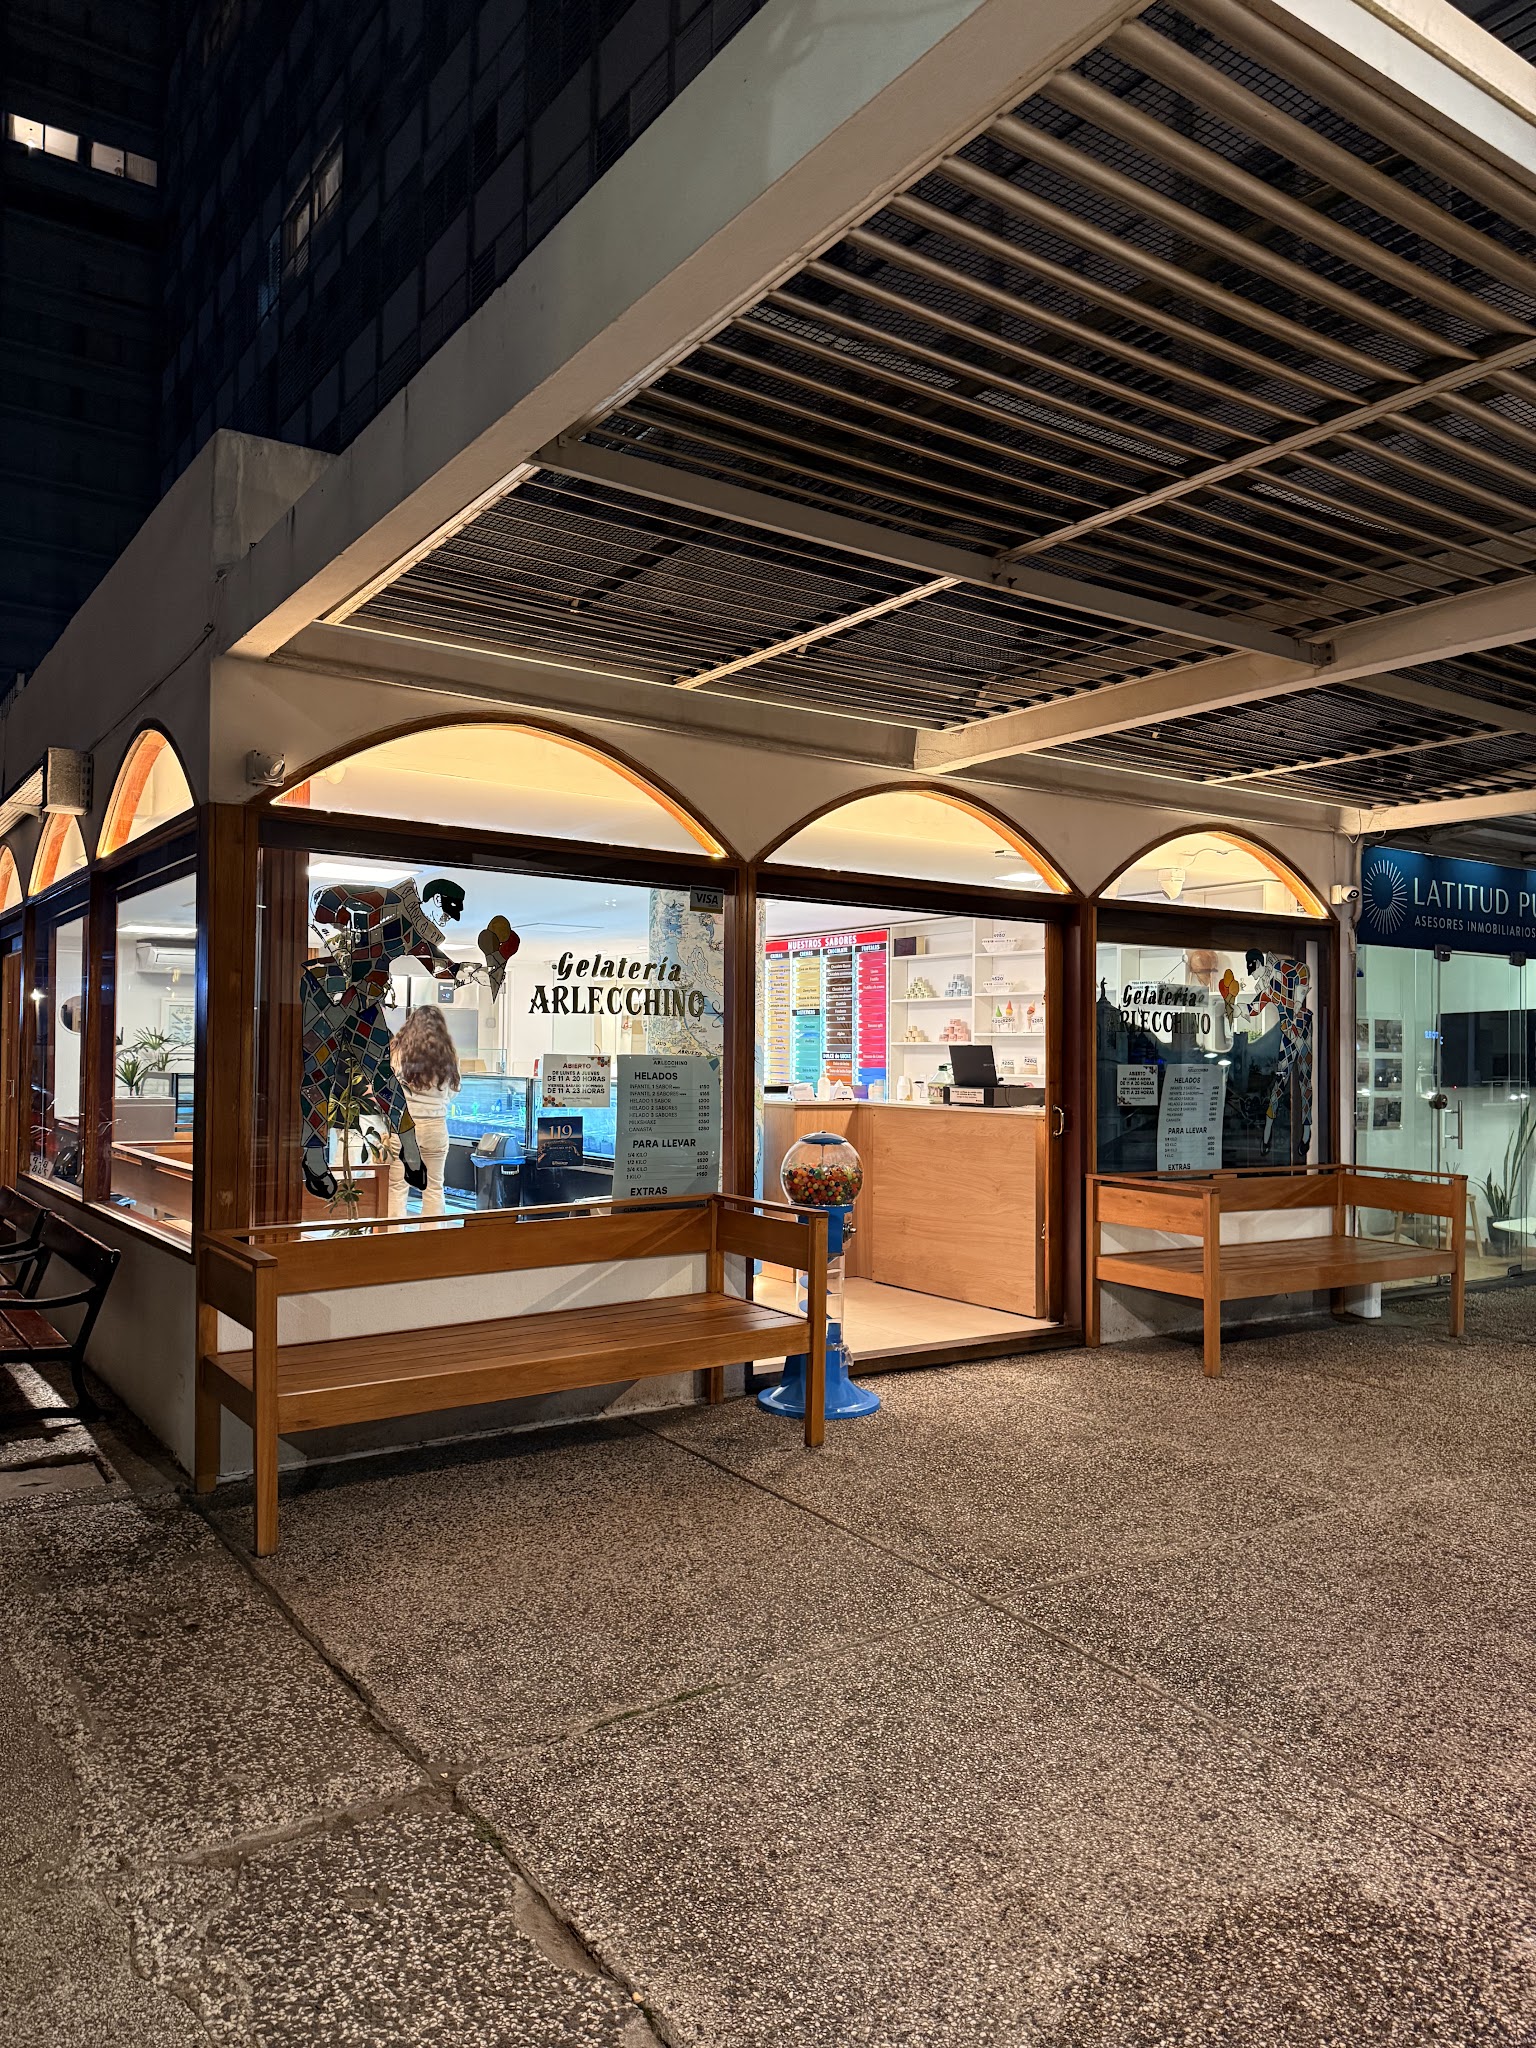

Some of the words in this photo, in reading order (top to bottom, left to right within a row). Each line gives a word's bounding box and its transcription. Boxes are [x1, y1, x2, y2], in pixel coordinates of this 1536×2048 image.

[695, 893, 719, 905] VISA
[1414, 877, 1509, 915] LATITUD
[1414, 915, 1464, 931] ASESORES
[1467, 921, 1536, 938] INMOBILIARIOS
[788, 939, 822, 950] NUESTROS
[825, 934, 857, 947] SABORES
[556, 951, 682, 982] Gelatería
[528, 985, 705, 1018] ARLECCHINO
[1122, 985, 1197, 1008] Gelatería
[634, 1072, 678, 1080] HELADOS
[549, 1125, 573, 1139] 119
[633, 1140, 658, 1148] PARA
[662, 1139, 696, 1147] LLEVAR
[630, 1187, 668, 1196] EXTRAS
